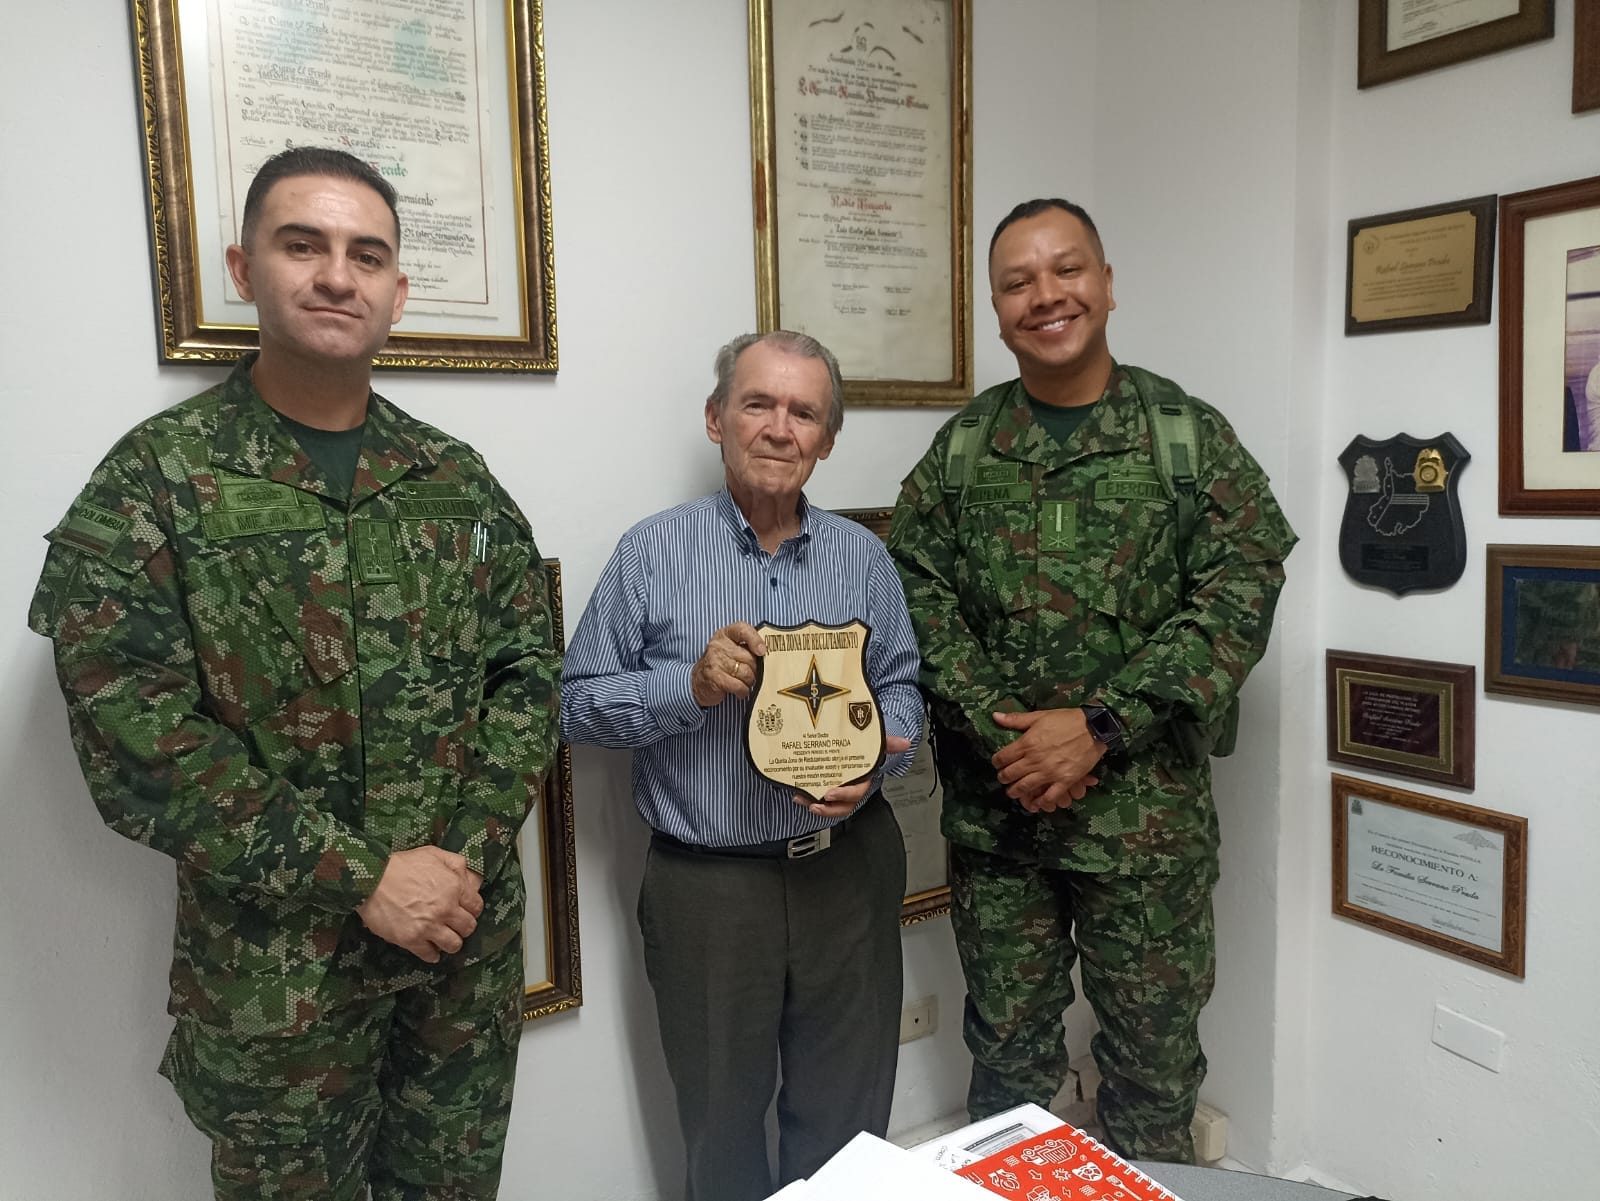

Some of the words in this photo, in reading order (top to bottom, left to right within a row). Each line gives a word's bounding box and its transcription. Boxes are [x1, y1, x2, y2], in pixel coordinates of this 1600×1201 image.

[764, 633, 786, 656] QUINTA
[786, 633, 801, 652] ZONA
[802, 633, 811, 651] DE
[811, 631, 859, 651] RECLUTAMIENTO
[811, 683, 819, 696] 5
[781, 741, 802, 750] RAFAEL
[803, 739, 831, 749] SERRANO
[832, 738, 851, 748] PRADA
[1371, 845, 1465, 878] RECONOCIMIENTO
